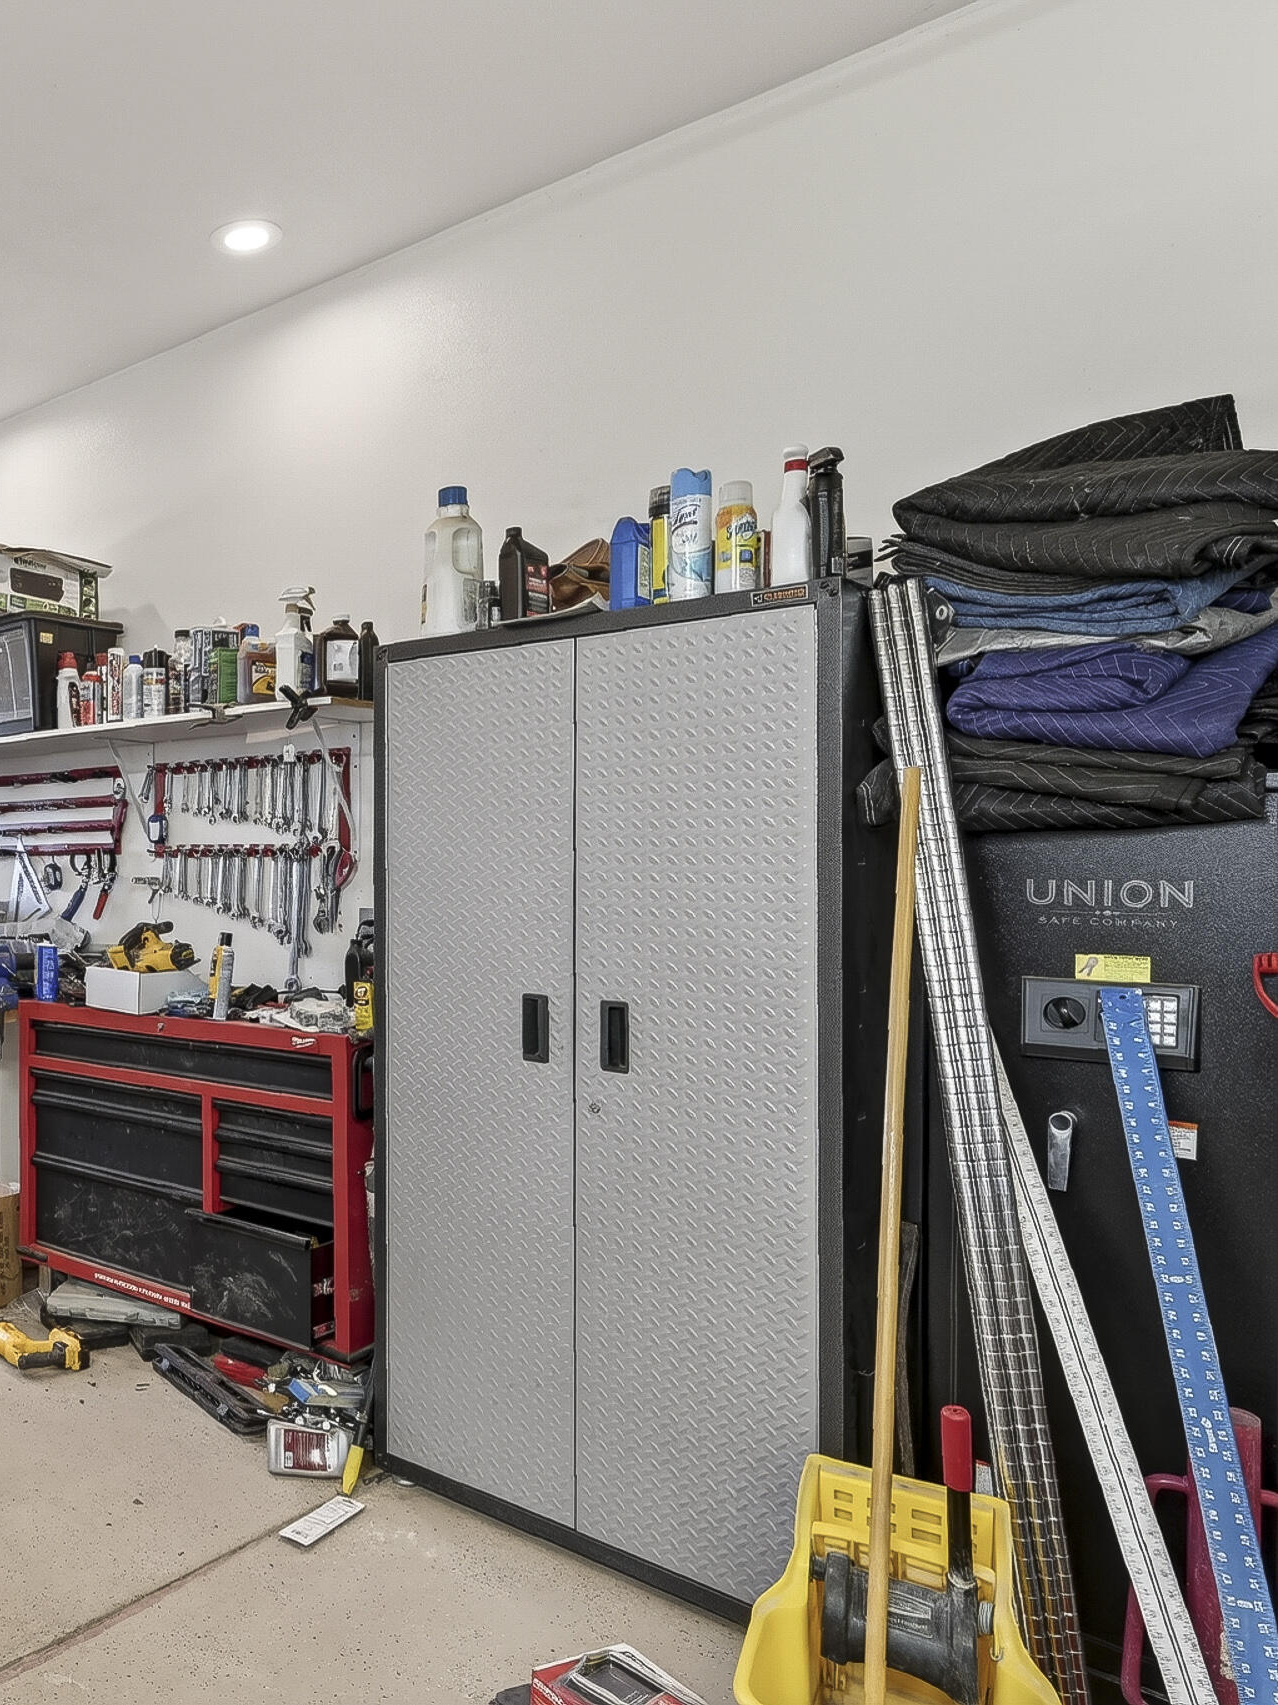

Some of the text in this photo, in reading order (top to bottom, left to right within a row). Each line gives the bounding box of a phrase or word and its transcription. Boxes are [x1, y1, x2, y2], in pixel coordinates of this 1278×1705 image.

[1026, 878, 1195, 908] UNION
[1037, 915, 1178, 928] SAFE COMPANY
